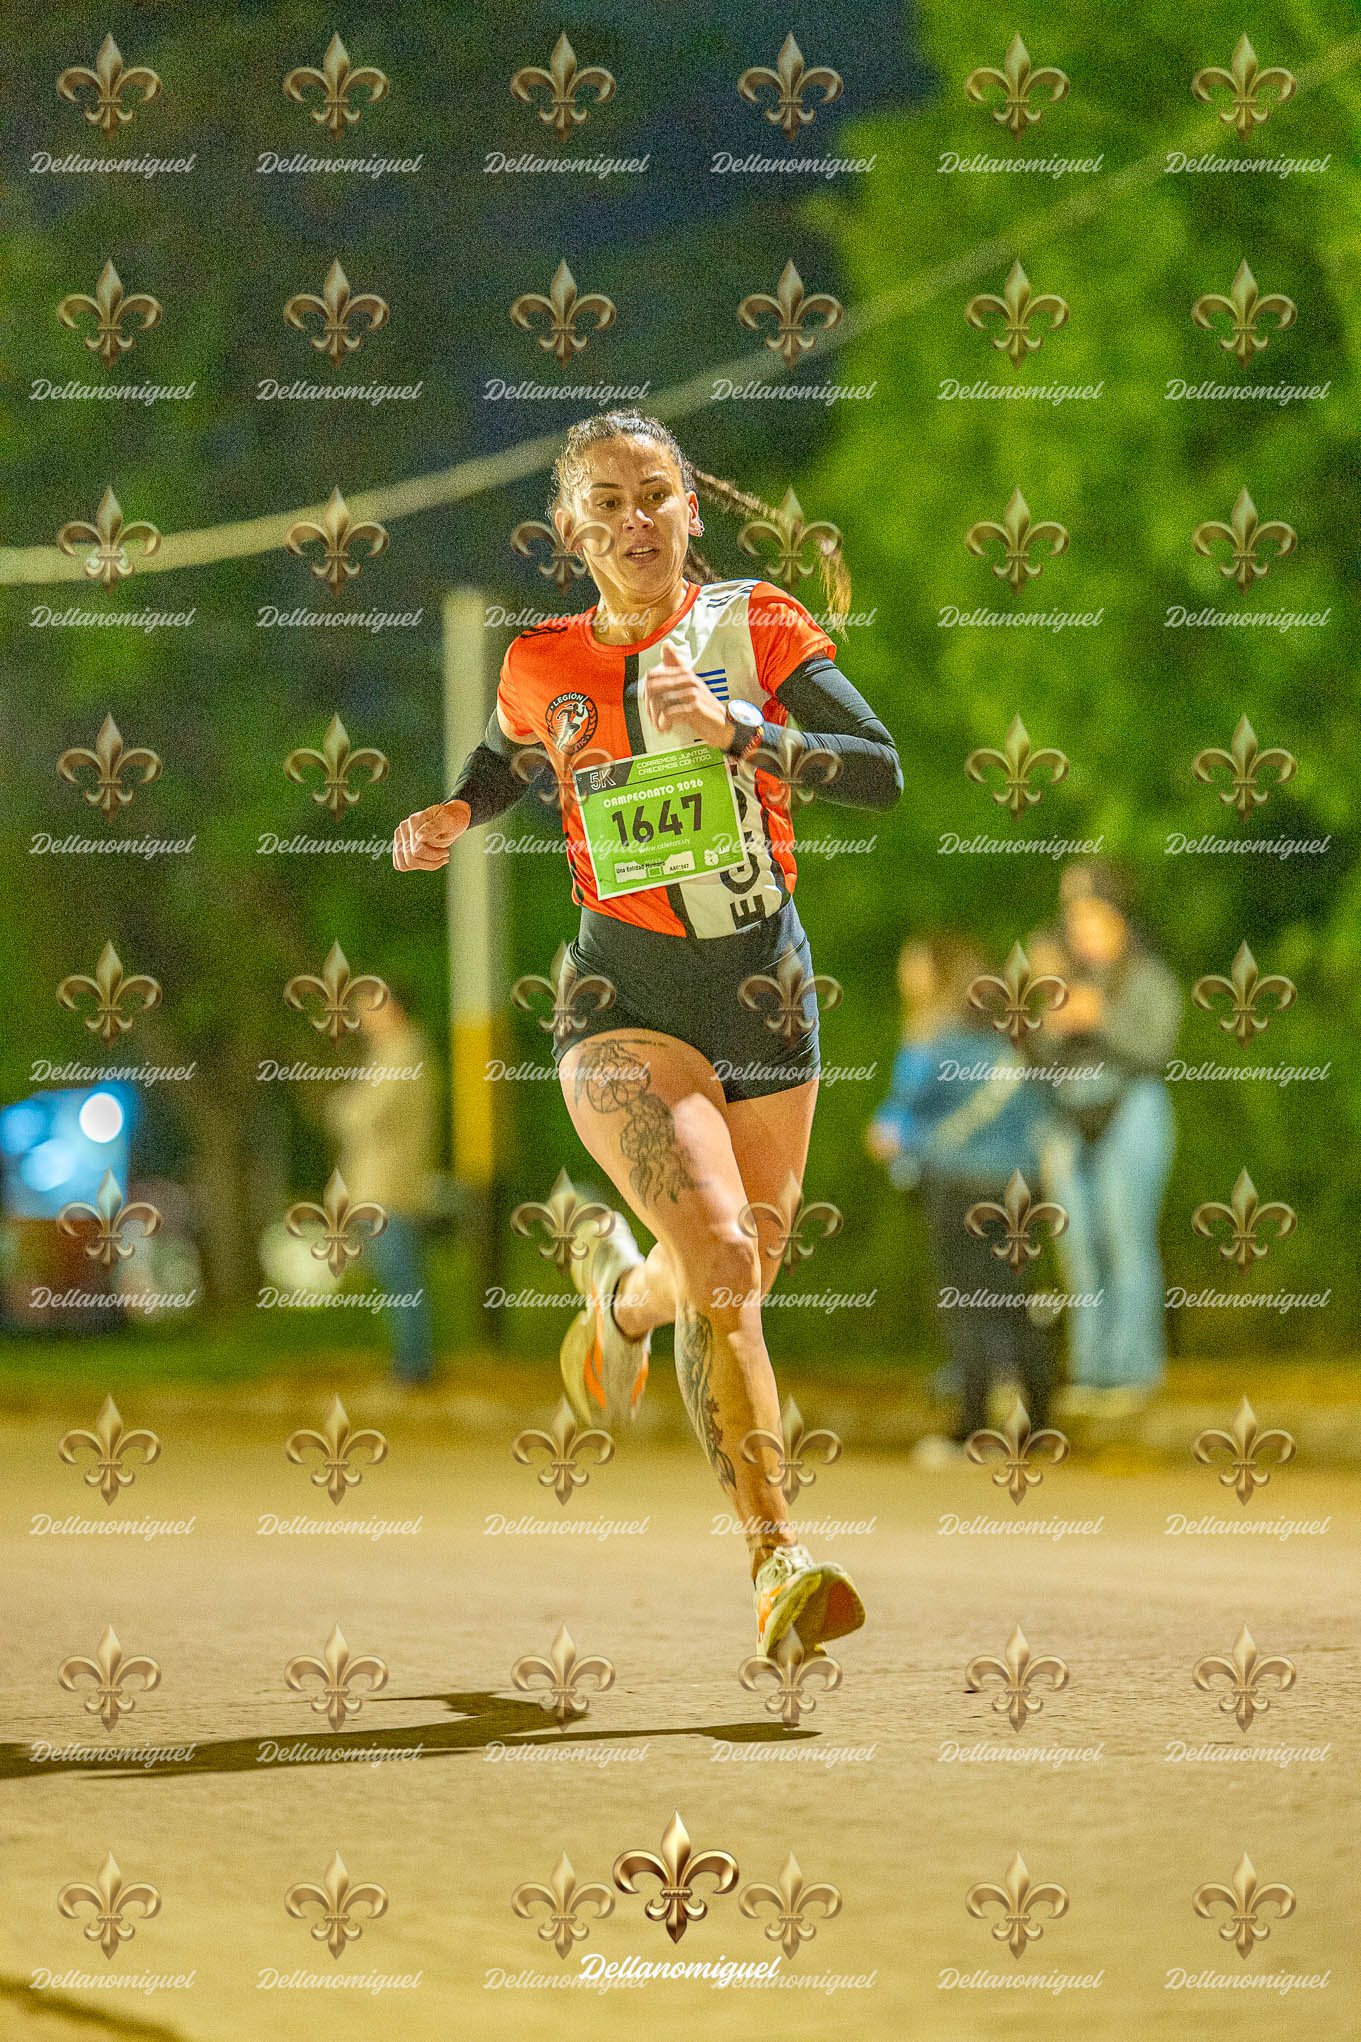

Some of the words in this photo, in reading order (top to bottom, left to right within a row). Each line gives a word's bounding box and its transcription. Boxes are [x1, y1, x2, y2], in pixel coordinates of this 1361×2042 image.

[590, 767, 617, 791] 5K
[603, 784, 674, 808] CAMPEONATO
[677, 778, 704, 792] 2026
[611, 792, 702, 847] 1647
